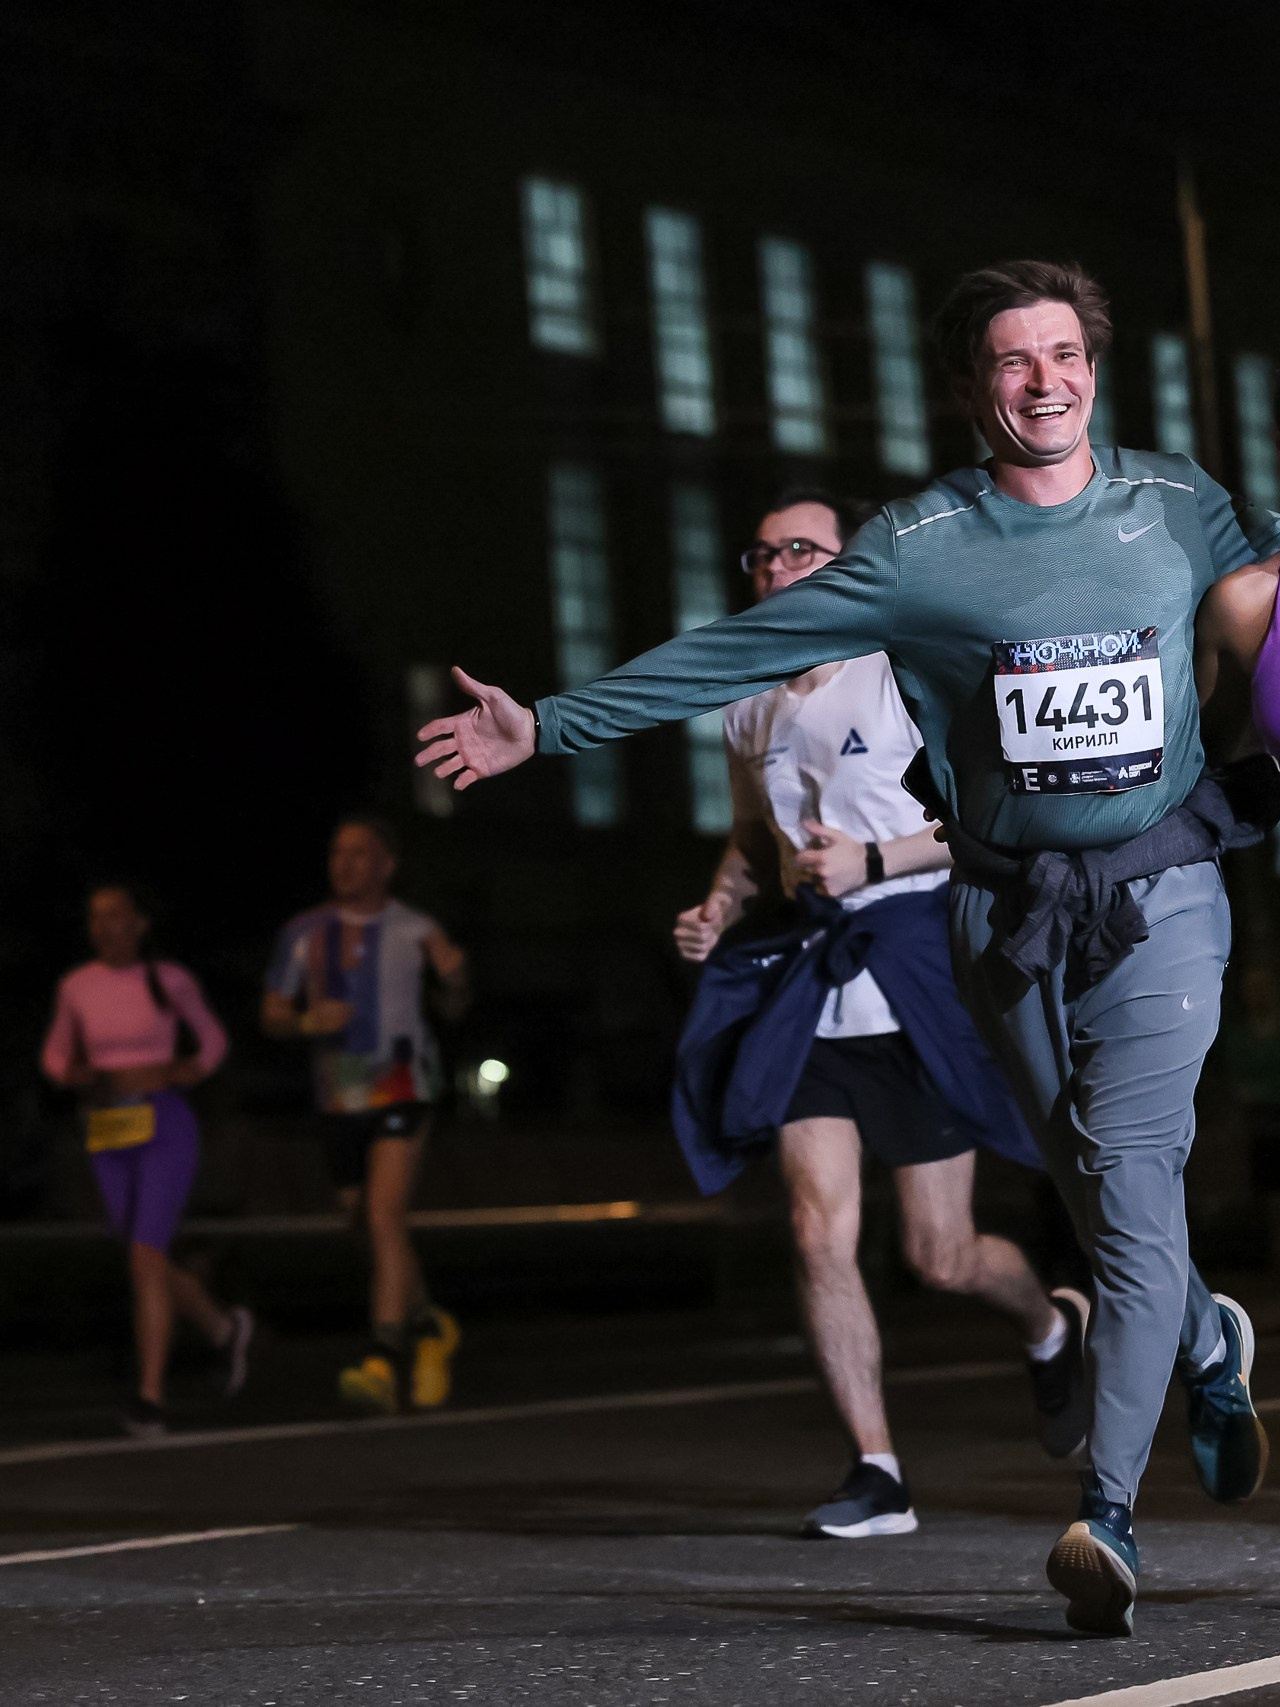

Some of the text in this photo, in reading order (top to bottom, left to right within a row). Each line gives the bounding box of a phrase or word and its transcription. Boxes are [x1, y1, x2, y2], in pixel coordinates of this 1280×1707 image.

[1009, 630, 1142, 666] НОЧНОЙ
[1005, 674, 1152, 734] 14431
[1052, 731, 1118, 750] КИРИЛЛ
[1021, 768, 1041, 791] E
